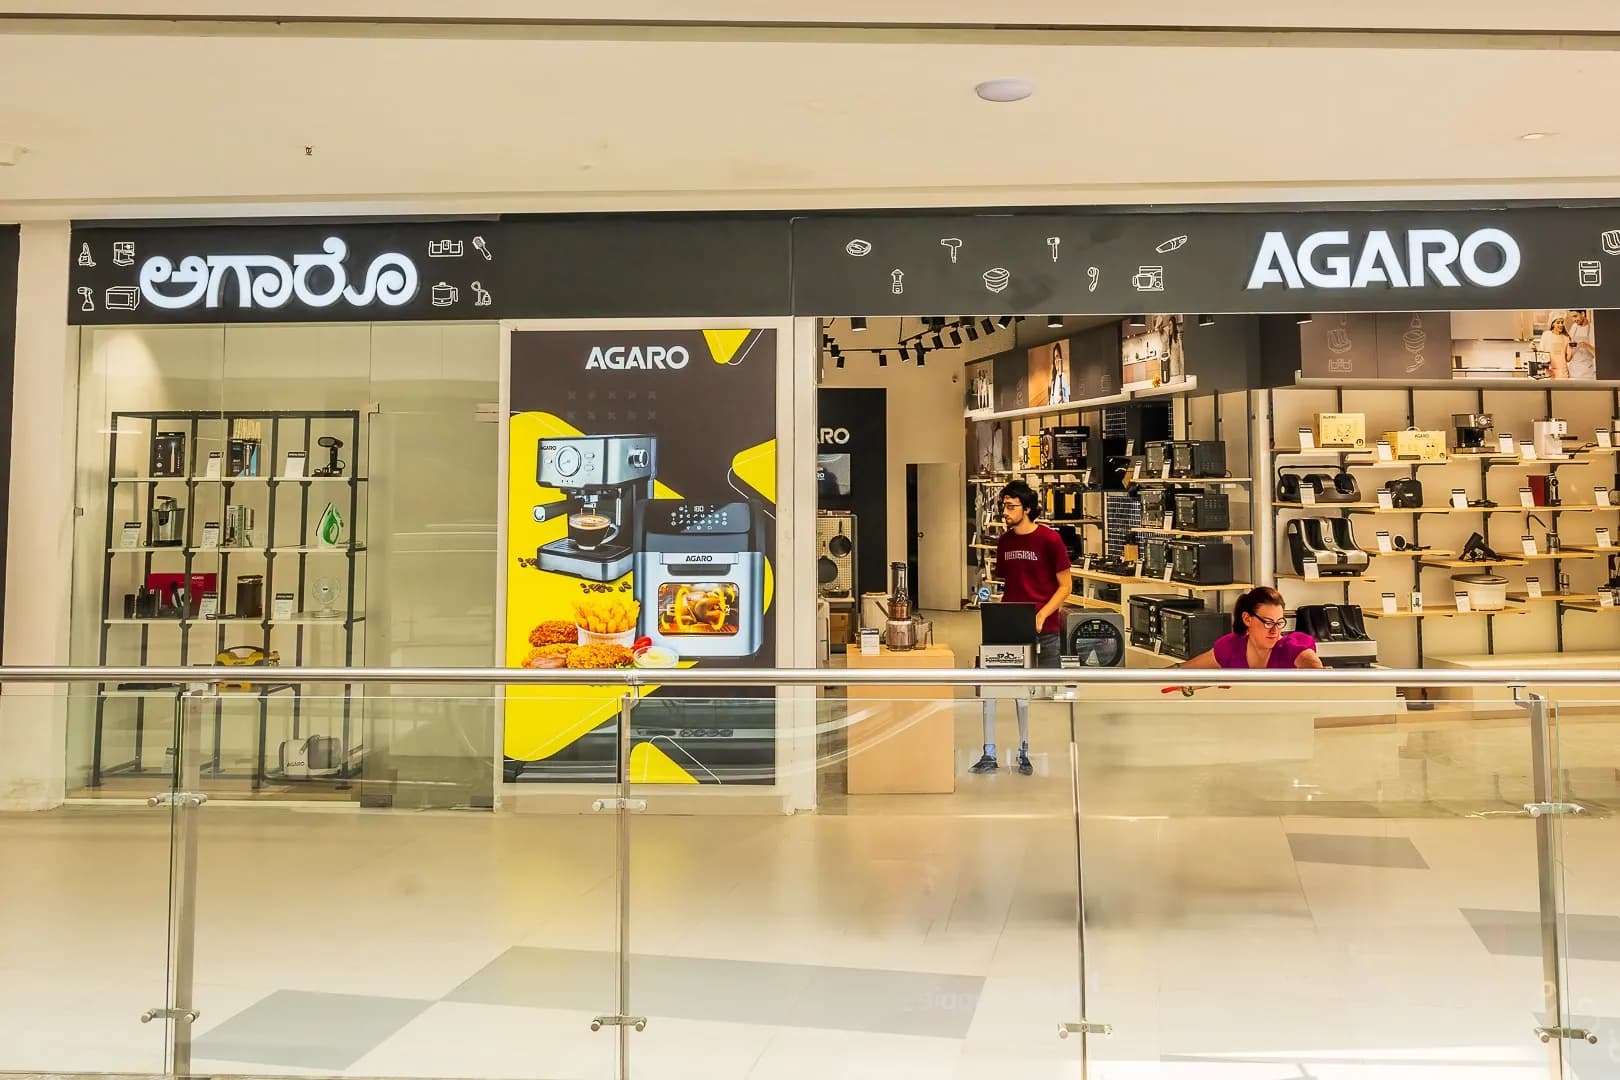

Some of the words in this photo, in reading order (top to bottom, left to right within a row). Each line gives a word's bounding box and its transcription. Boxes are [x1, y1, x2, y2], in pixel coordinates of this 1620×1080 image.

[1247, 228, 1521, 289] AGARO
[139, 237, 418, 309] ಅಗಾರೊ
[585, 346, 690, 370] AGARO
[816, 427, 850, 445] RO
[286, 760, 305, 768] AGARO
